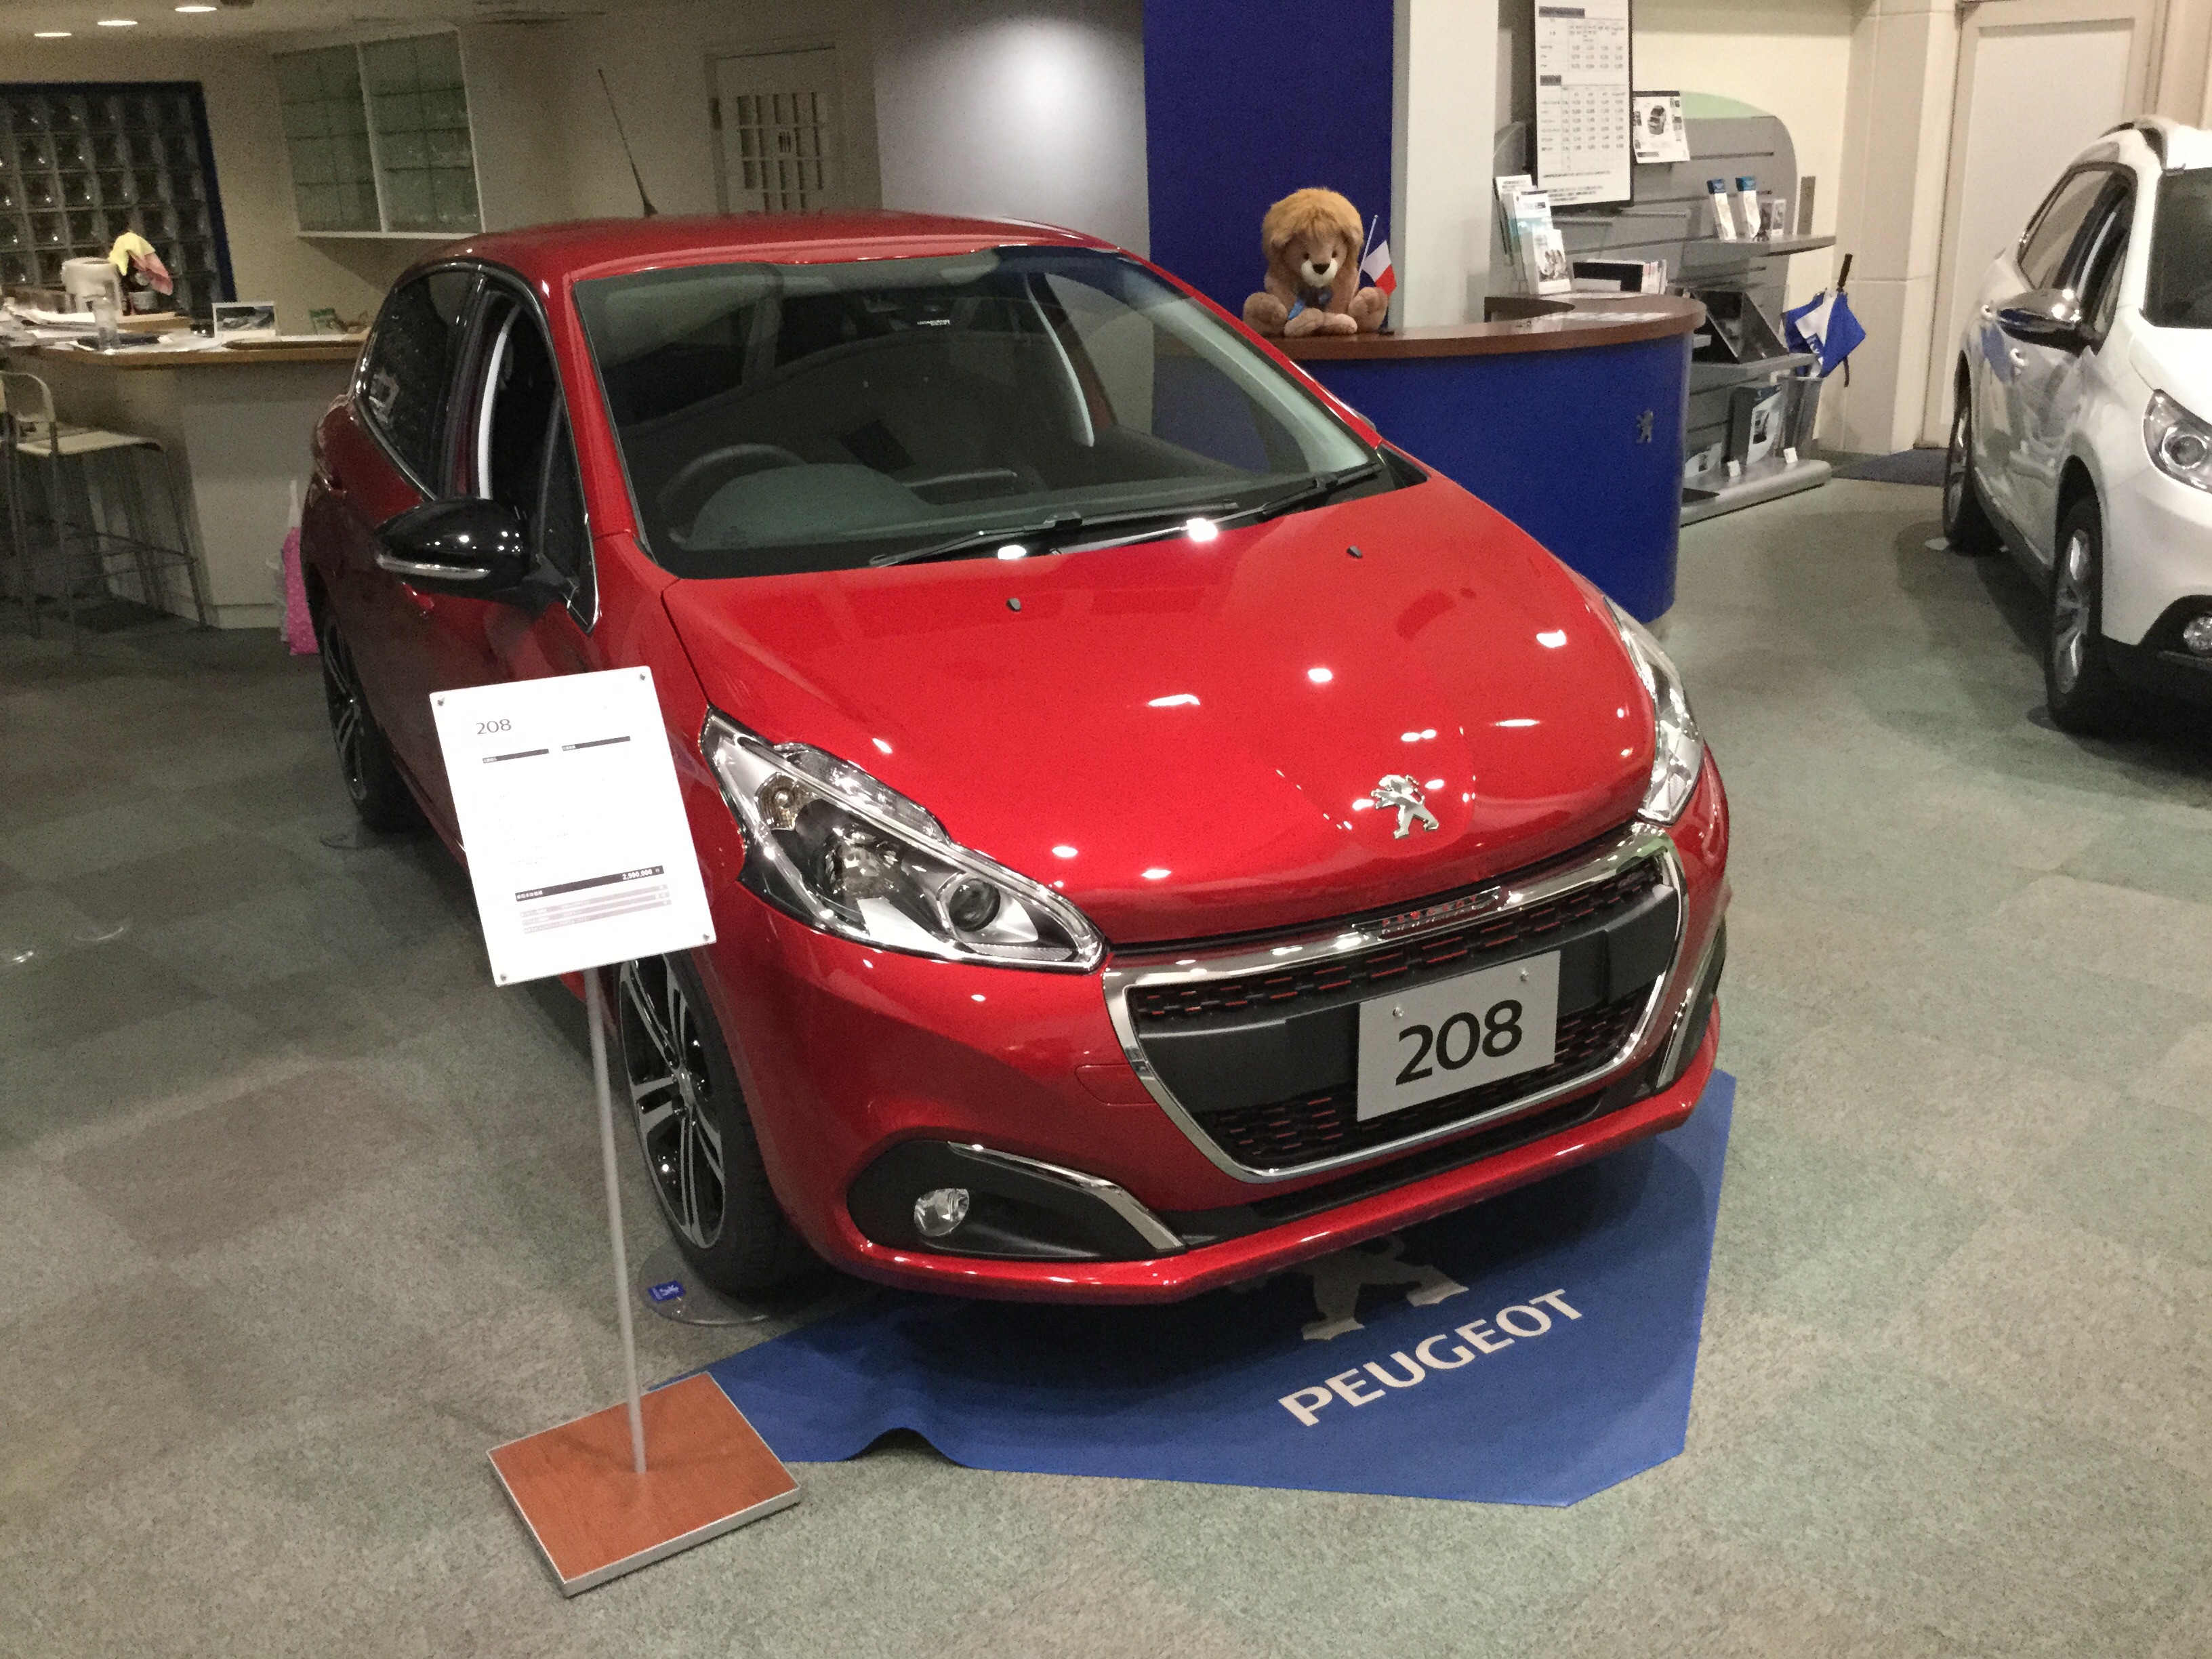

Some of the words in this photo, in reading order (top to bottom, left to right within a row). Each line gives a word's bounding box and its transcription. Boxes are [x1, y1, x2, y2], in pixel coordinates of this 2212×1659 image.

[476, 719, 512, 735] 208
[1382, 895, 1477, 926] PEUGEOT
[1395, 1000, 1523, 1086] 208
[1278, 1288, 1582, 1427] PEUGEOT
